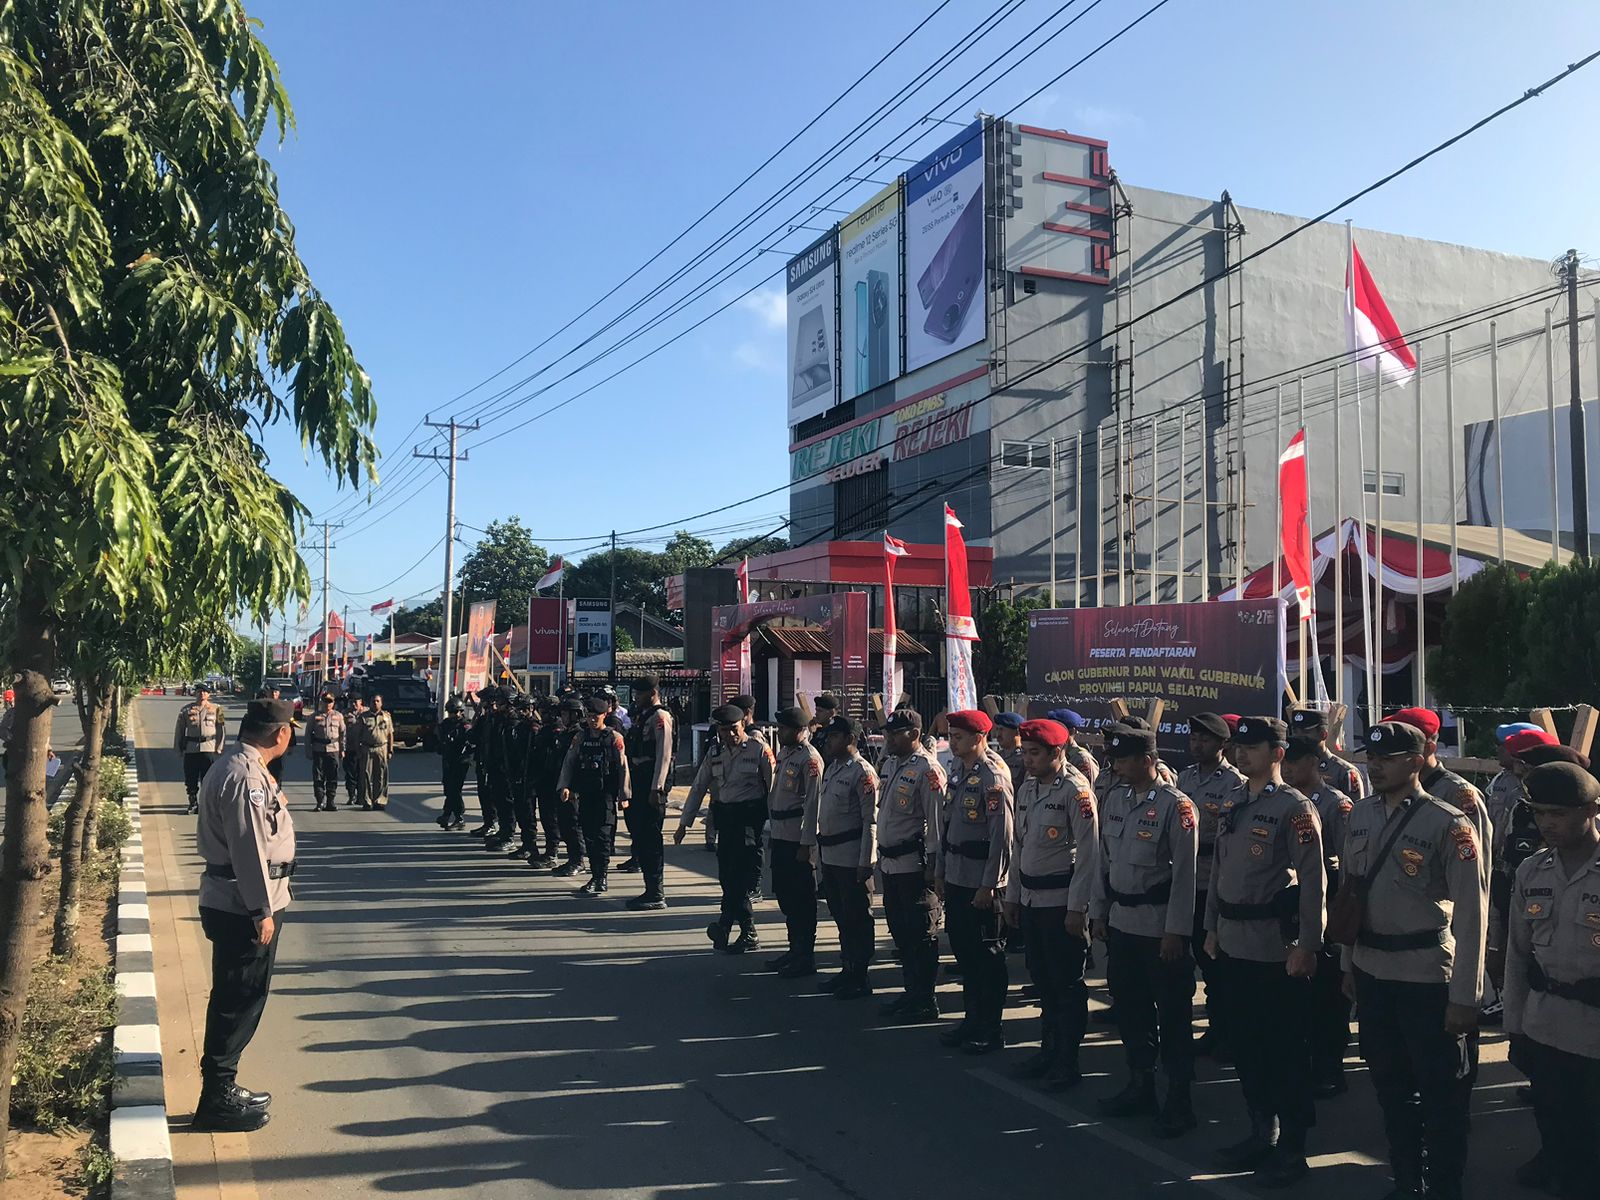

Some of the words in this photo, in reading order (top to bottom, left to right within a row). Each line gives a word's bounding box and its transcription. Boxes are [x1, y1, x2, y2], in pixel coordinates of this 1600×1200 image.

[924, 145, 962, 182] vivo
[846, 240, 866, 259] realme
[872, 223, 889, 242] Series
[790, 239, 832, 283] SAMSUNG
[893, 405, 918, 426] TOKO
[915, 392, 947, 417] EMAS
[892, 400, 974, 463] REJEKI
[791, 419, 881, 482] REJEKI
[822, 452, 884, 486] SELULER
[1103, 619, 1145, 638] Selamat
[1140, 618, 1180, 640] Datang
[1089, 648, 1126, 658] PESERTA
[1129, 646, 1197, 658] PENDAFTARAN
[1044, 669, 1075, 684] CALON
[1077, 665, 1130, 680] GUBERNUR
[1133, 665, 1156, 677] DAN
[1160, 666, 1195, 680] WAKIL
[1199, 669, 1265, 690] GUBERNUR
[1079, 681, 1125, 695] PROVINSI
[1128, 681, 1164, 694] PAPUA
[1168, 683, 1218, 700] SELATAN
[1137, 819, 1159, 828] POLRI
[1252, 814, 1278, 825] POLRI
[1402, 834, 1433, 850] POLRI
[1582, 892, 1600, 904] PO
